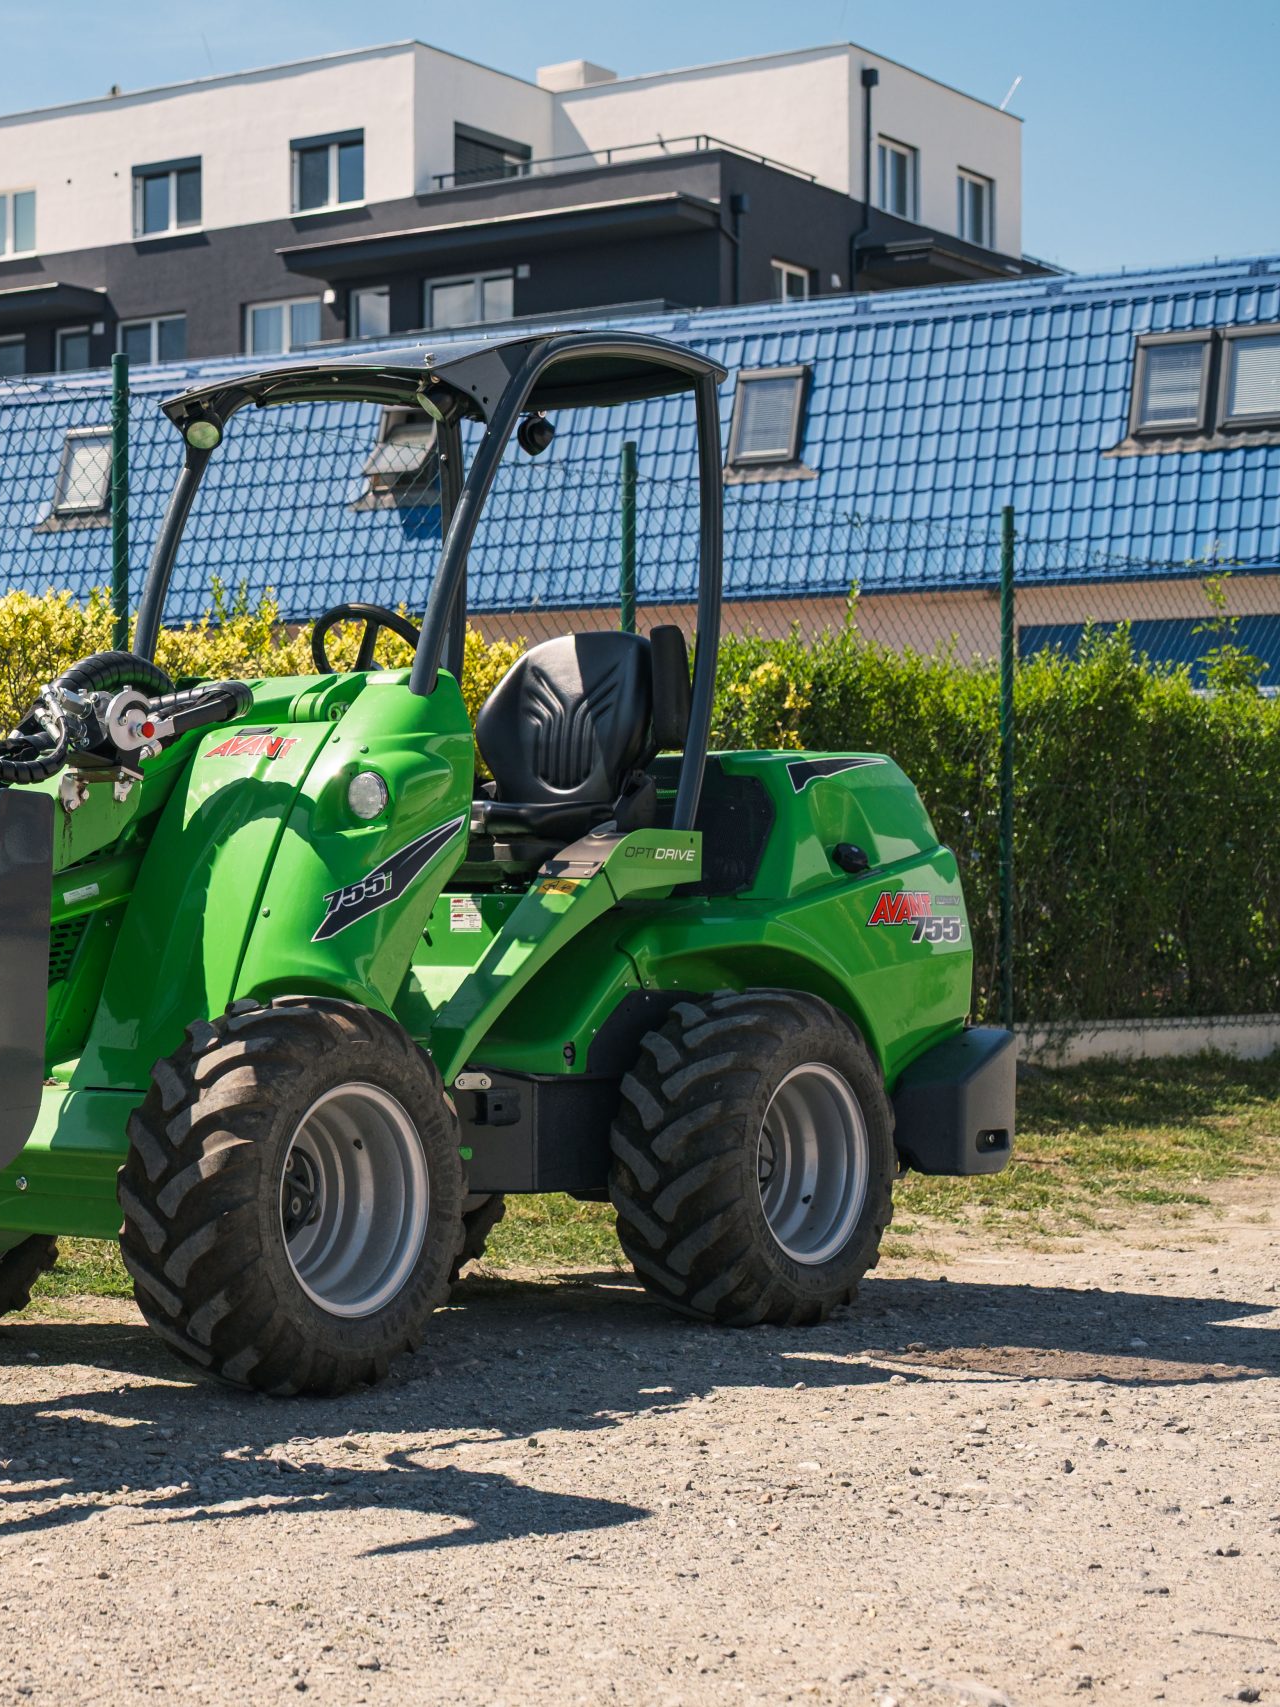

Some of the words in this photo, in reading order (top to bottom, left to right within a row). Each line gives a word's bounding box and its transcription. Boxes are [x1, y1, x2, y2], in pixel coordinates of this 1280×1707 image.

[203, 735, 298, 760] AVANT
[624, 846, 696, 862] OPTIDRIVE
[323, 871, 392, 915] 755i
[866, 891, 932, 927] AVANT
